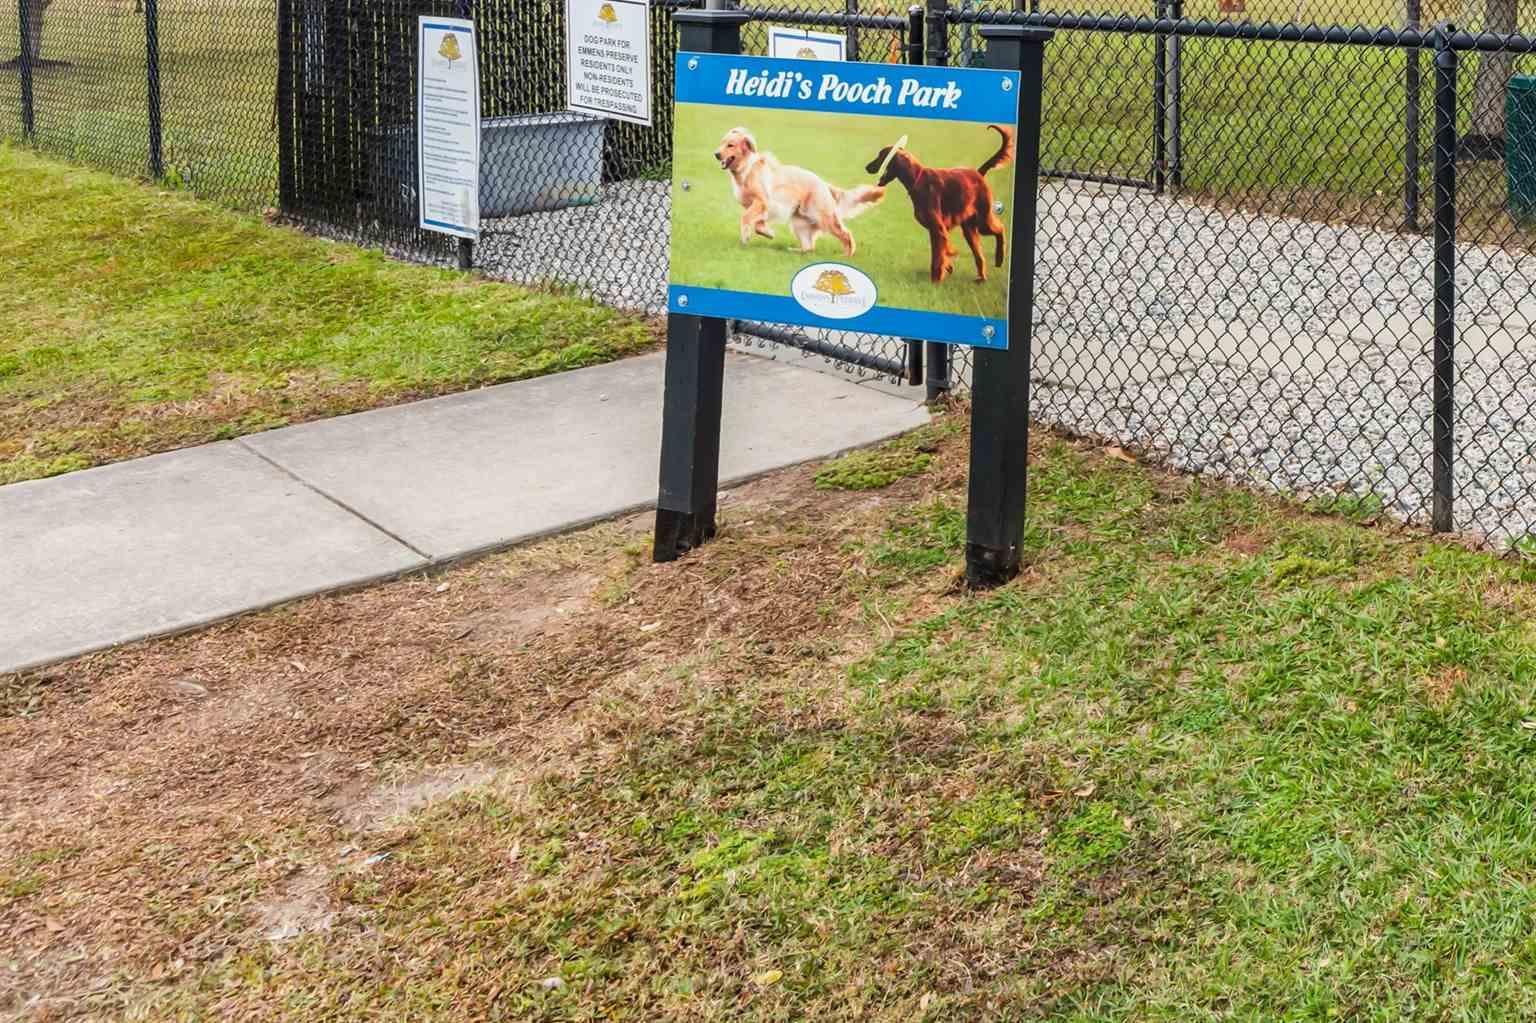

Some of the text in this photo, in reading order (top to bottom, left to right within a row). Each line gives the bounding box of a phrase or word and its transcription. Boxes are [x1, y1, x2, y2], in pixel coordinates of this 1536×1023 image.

[584, 34, 631, 49] DOG PARK FOR
[577, 46, 639, 64] EMMENS PRESERVE
[580, 58, 633, 75] RESIDENTS ONLY
[576, 82, 643, 103] WILL BE PROSECUTED
[725, 68, 963, 110] Heidi's Pooch Park
[580, 95, 637, 114] FOR TRESPASSING
